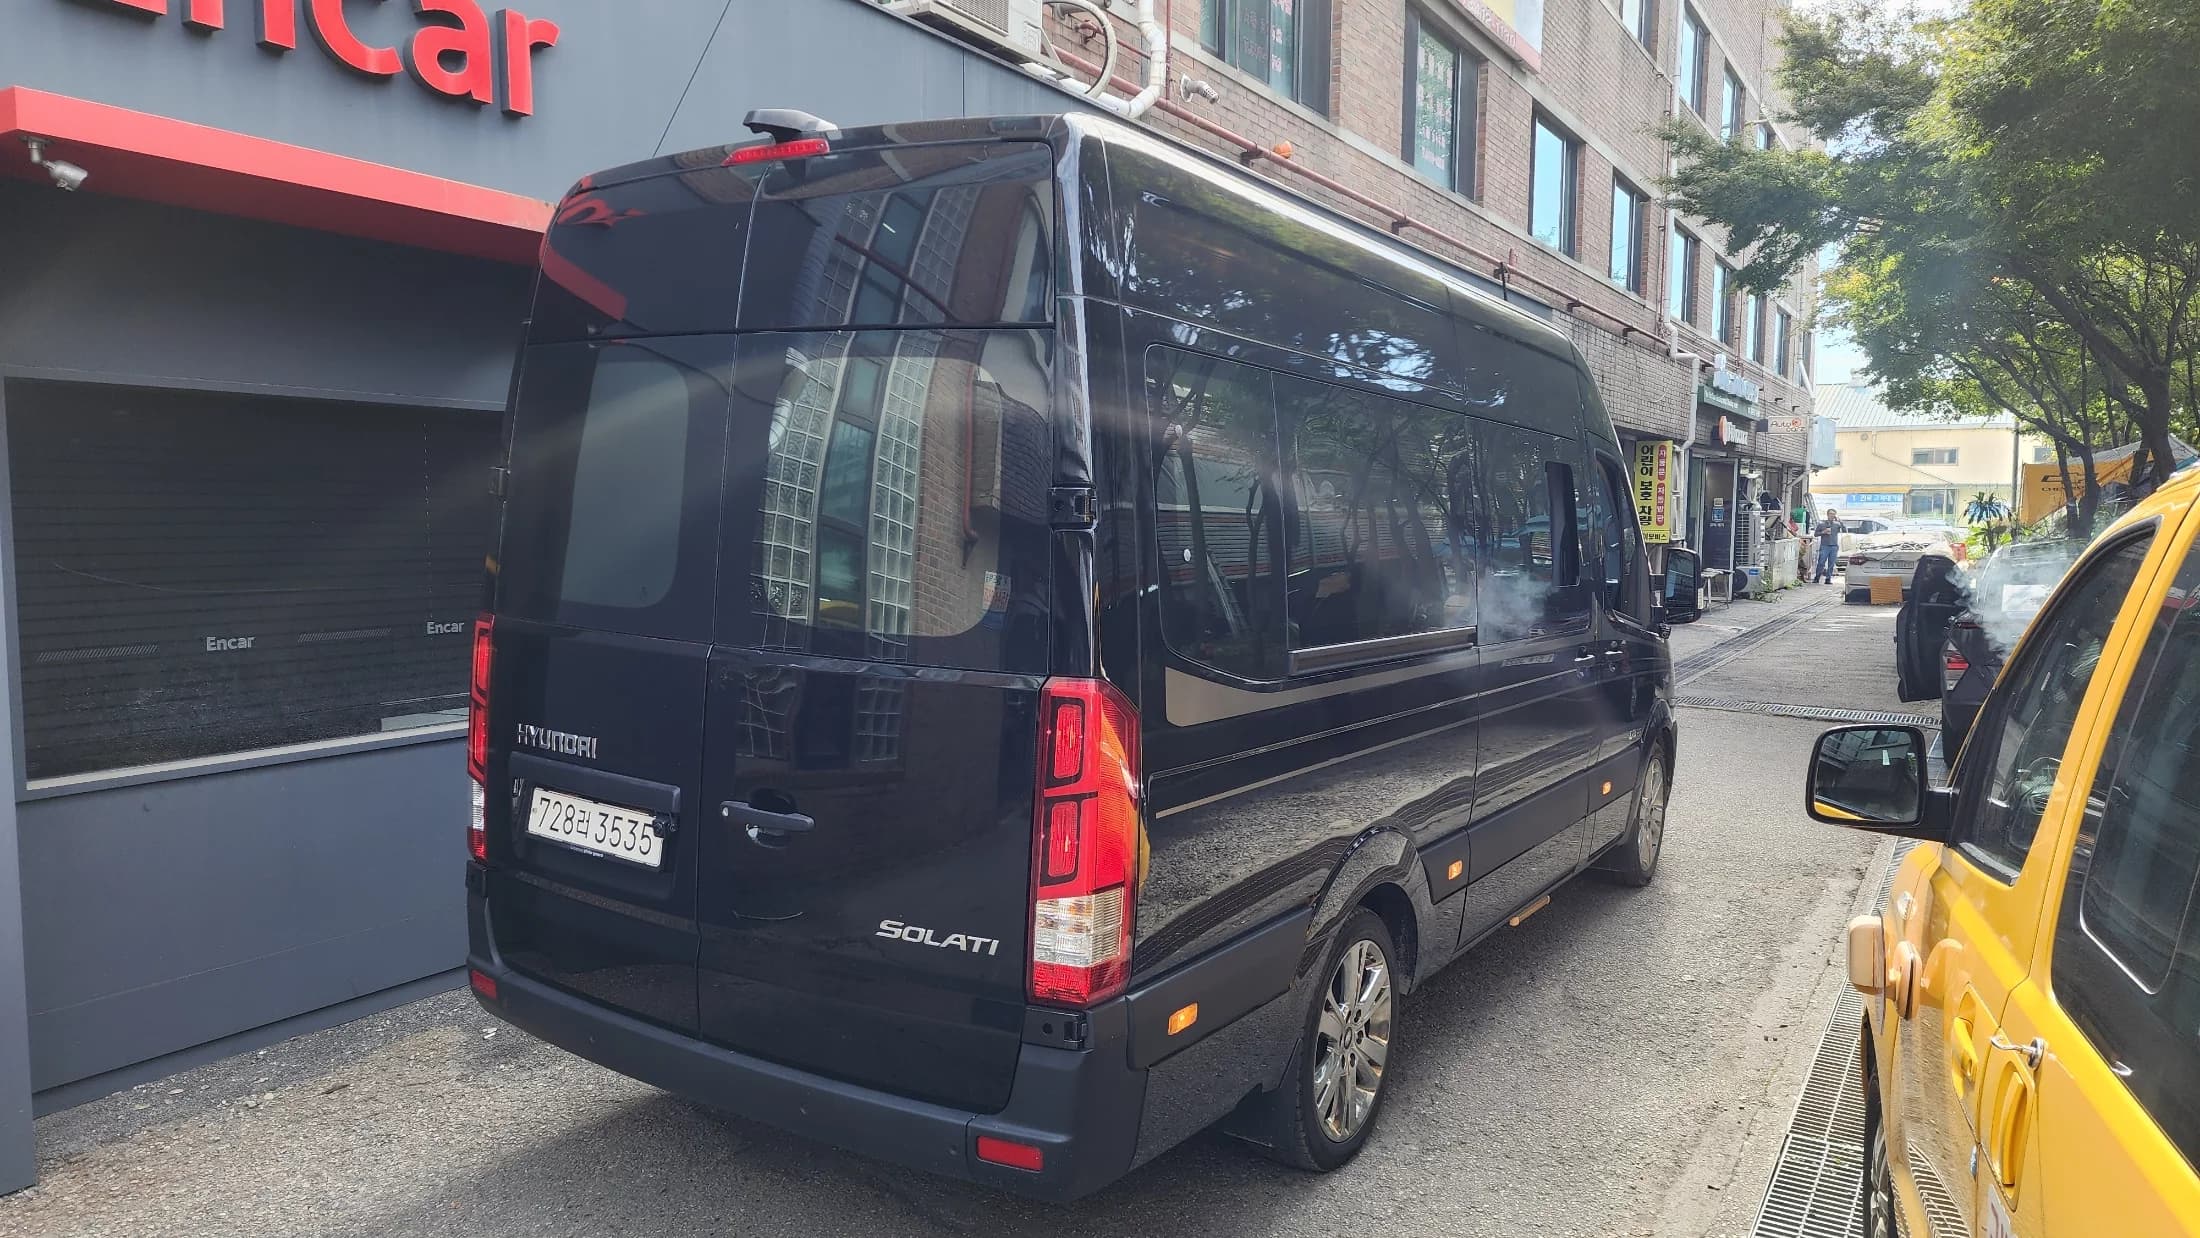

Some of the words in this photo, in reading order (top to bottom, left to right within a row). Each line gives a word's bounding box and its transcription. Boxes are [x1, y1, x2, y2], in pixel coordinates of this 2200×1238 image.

[98, 0, 561, 117] car
[1639, 444, 1654, 477] 어린이
[1639, 480, 1653, 501] 보호
[1638, 505, 1653, 526] 차량
[206, 634, 256, 652] Encar
[426, 620, 465, 635] Encar
[517, 723, 599, 760] HYUNDAI
[594, 812, 653, 856] 3535
[874, 918, 1000, 956] SOLATI
